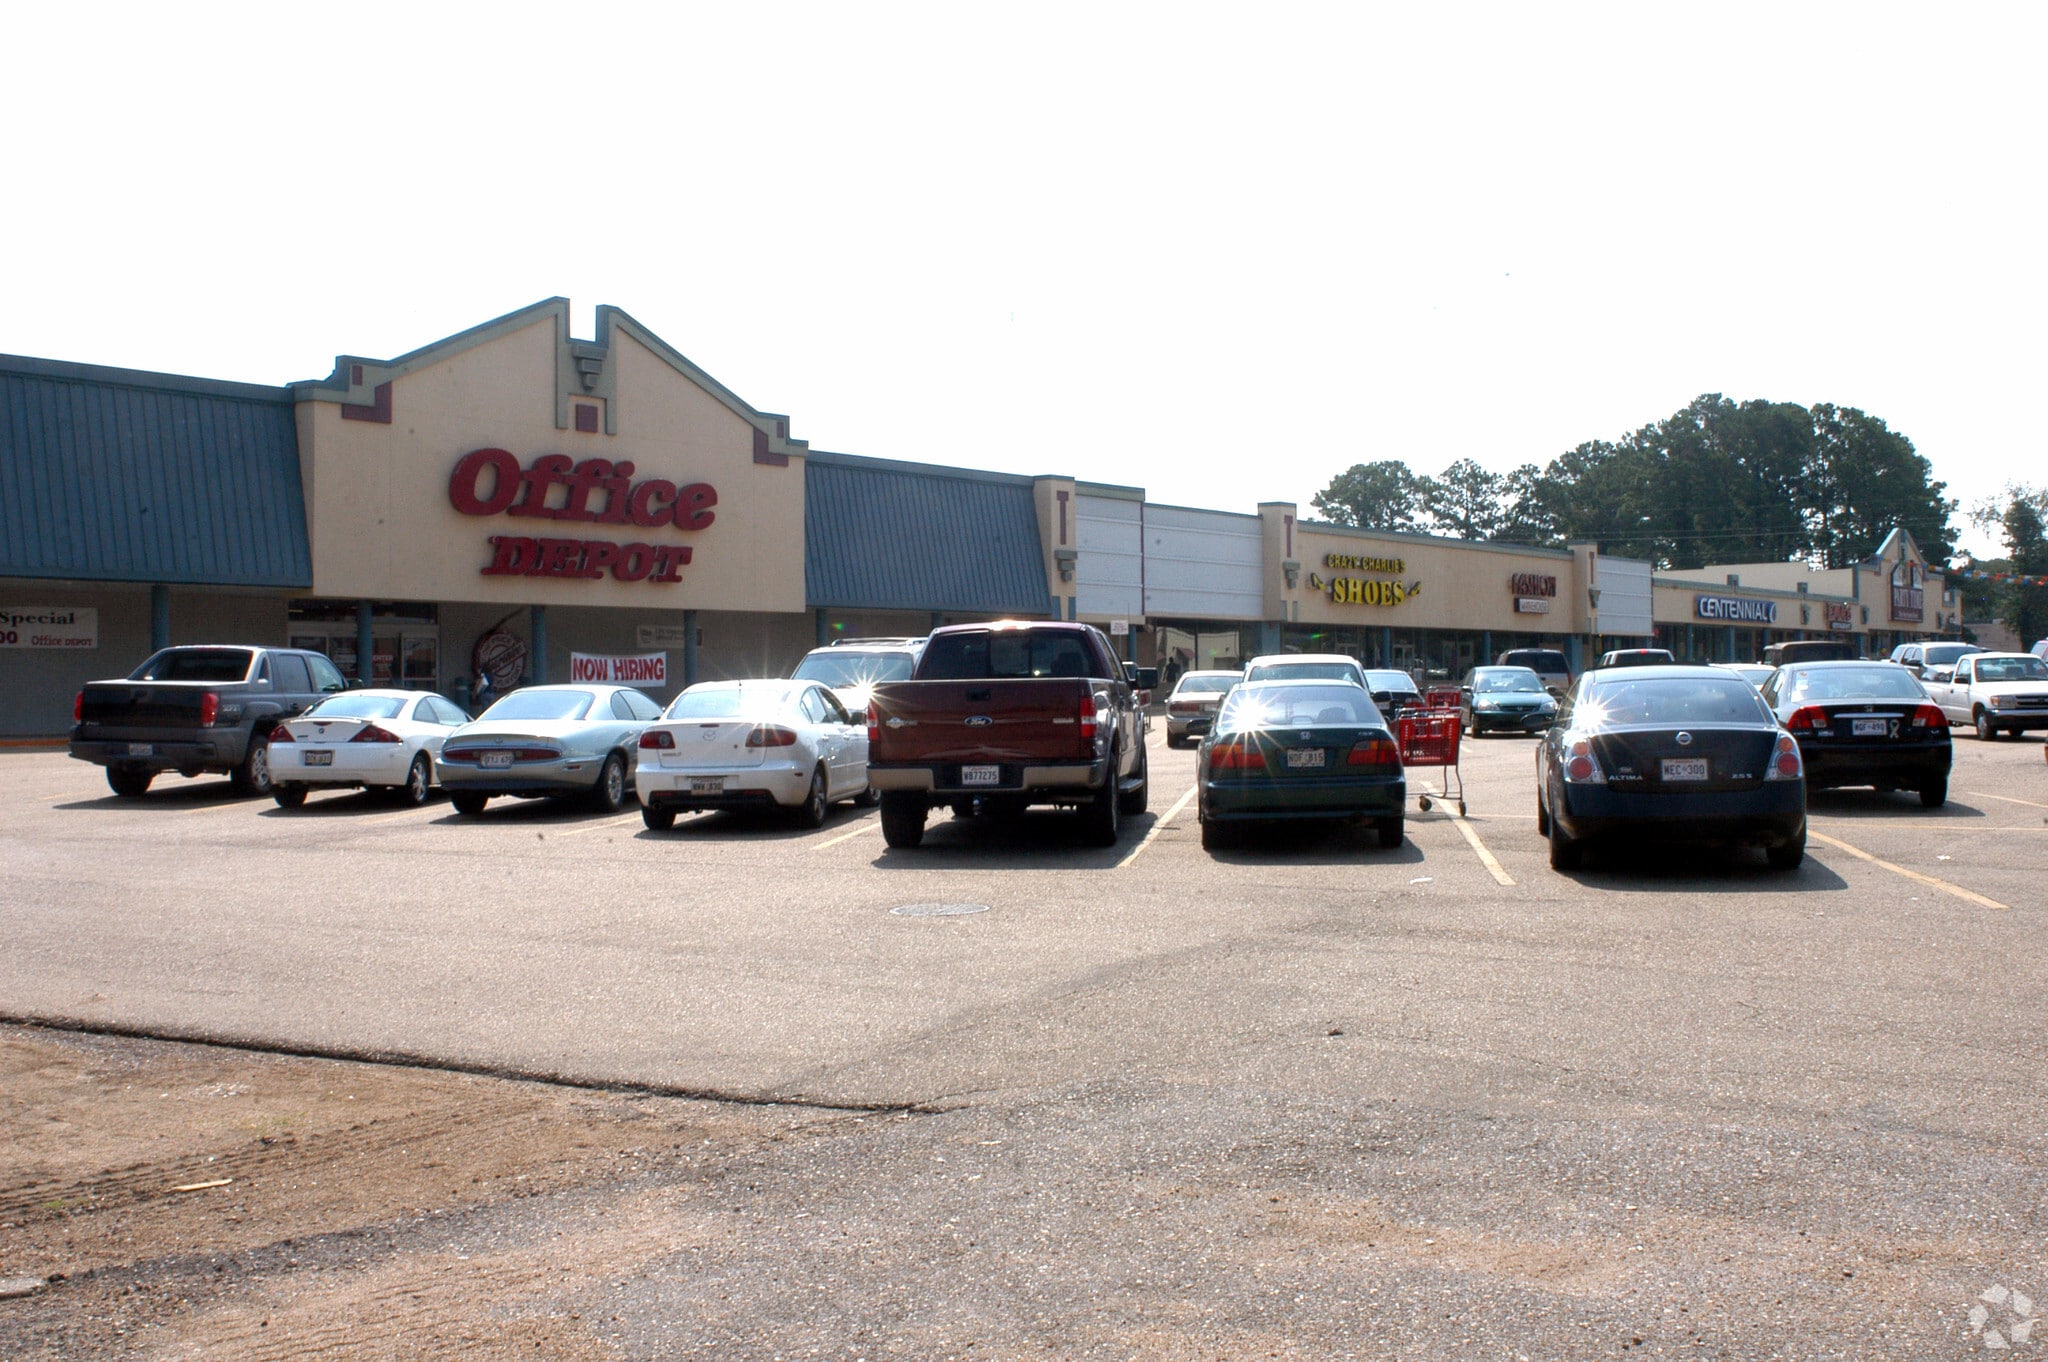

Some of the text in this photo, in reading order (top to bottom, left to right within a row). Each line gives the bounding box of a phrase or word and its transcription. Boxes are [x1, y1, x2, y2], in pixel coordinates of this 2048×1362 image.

[449, 448, 718, 531] Office
[481, 536, 693, 583] DEPOT
[1325, 554, 1358, 569] CRAZY
[1332, 578, 1406, 606] SHOES
[0, 611, 75, 627] Special
[1700, 598, 1768, 621] CENTENNIAL
[31, 635, 62, 646] Office
[65, 637, 92, 646] DEPOT
[572, 658, 665, 681] NOW HIRING
